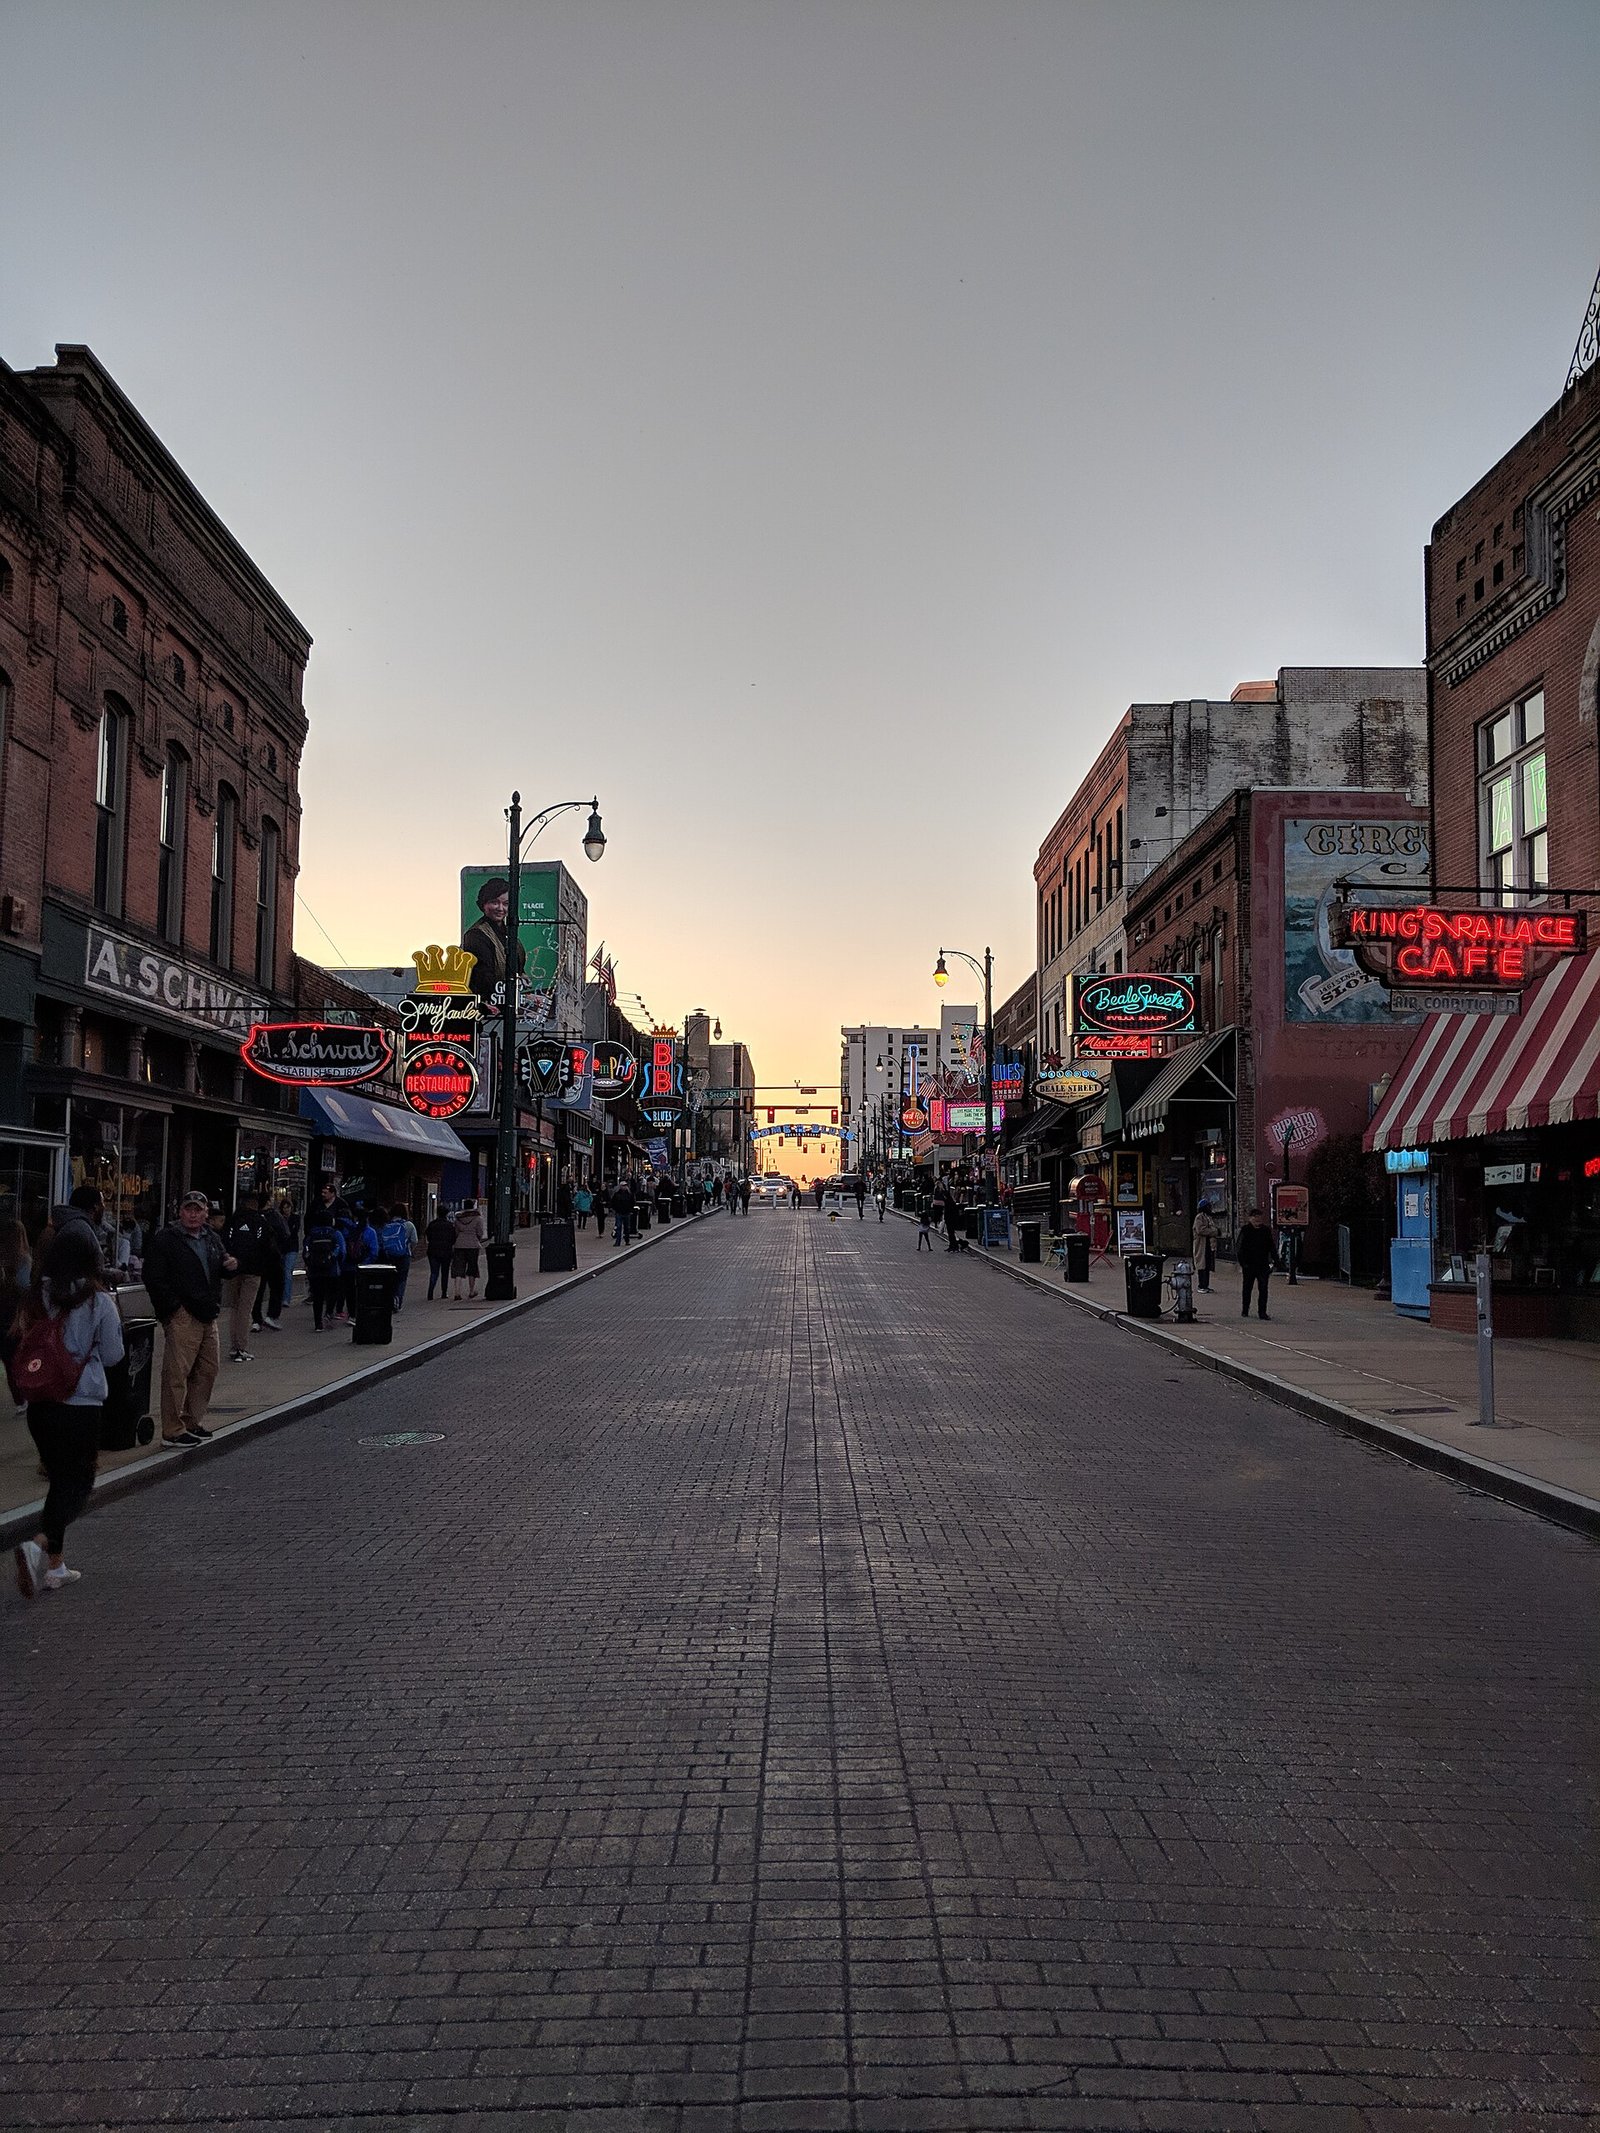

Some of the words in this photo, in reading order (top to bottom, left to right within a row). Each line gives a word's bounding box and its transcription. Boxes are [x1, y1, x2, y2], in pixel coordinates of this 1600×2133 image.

[1350, 906, 1444, 939] KING'S
[1456, 915, 1575, 943] PALACE
[1087, 985, 1140, 1010] Beale
[1137, 984, 1185, 1013] Sweets
[1395, 996, 1418, 1009] AIR
[1424, 997, 1515, 1011] CONDITIOND
[398, 998, 443, 1033] Jerry
[432, 996, 485, 1034] Lawler
[447, 1034, 471, 1042] FAME
[281, 1031, 379, 1061] Schwab
[1080, 1049, 1105, 1057] SOUL
[423, 1052, 456, 1066] BAR
[274, 1065, 341, 1078] ESTABLISHED
[343, 1067, 363, 1077] 1876
[592, 1053, 638, 1081] emphis
[992, 1062, 1021, 1081] LUES
[406, 1075, 472, 1092] RESTAURANT
[992, 1080, 1021, 1089] CITY
[1067, 1084, 1098, 1092] STREET
[709, 1090, 729, 1098] Second
[410, 1095, 428, 1111] 159
[429, 1095, 466, 1117] BEALE
[652, 1110, 673, 1121] BLUES
